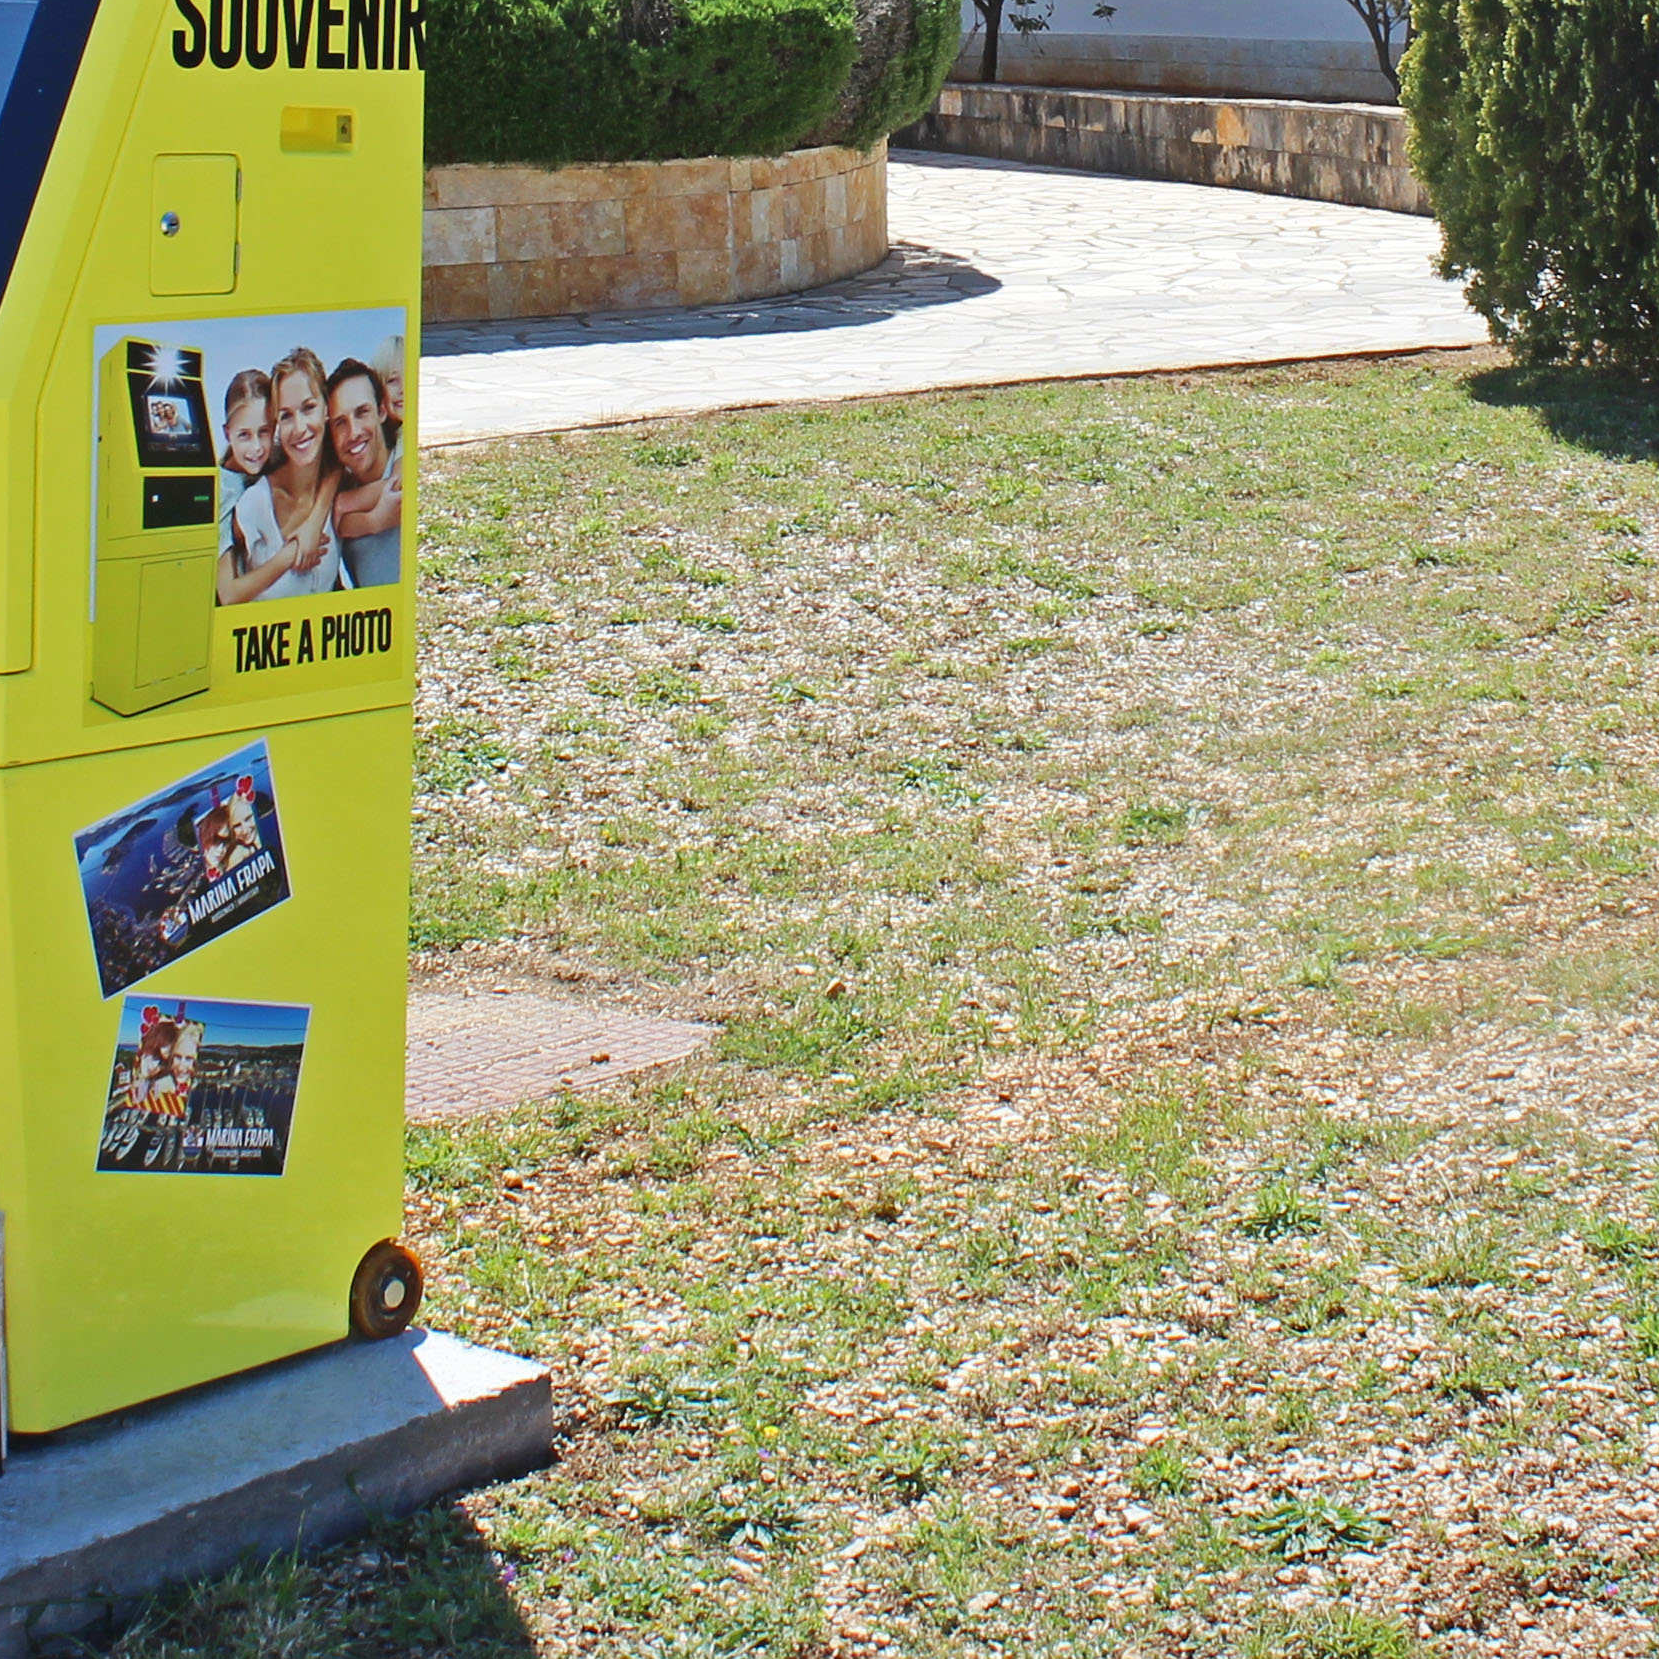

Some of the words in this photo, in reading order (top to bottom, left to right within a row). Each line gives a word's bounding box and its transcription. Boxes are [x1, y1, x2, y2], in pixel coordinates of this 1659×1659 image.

[232, 621, 292, 674] TAKE
[297, 619, 314, 665] A
[321, 607, 392, 661] PHOTO
[187, 876, 238, 925] MARINA
[236, 850, 276, 892] FRAPA
[205, 1128, 243, 1147] MARINA
[244, 1128, 274, 1147] FRAPA
